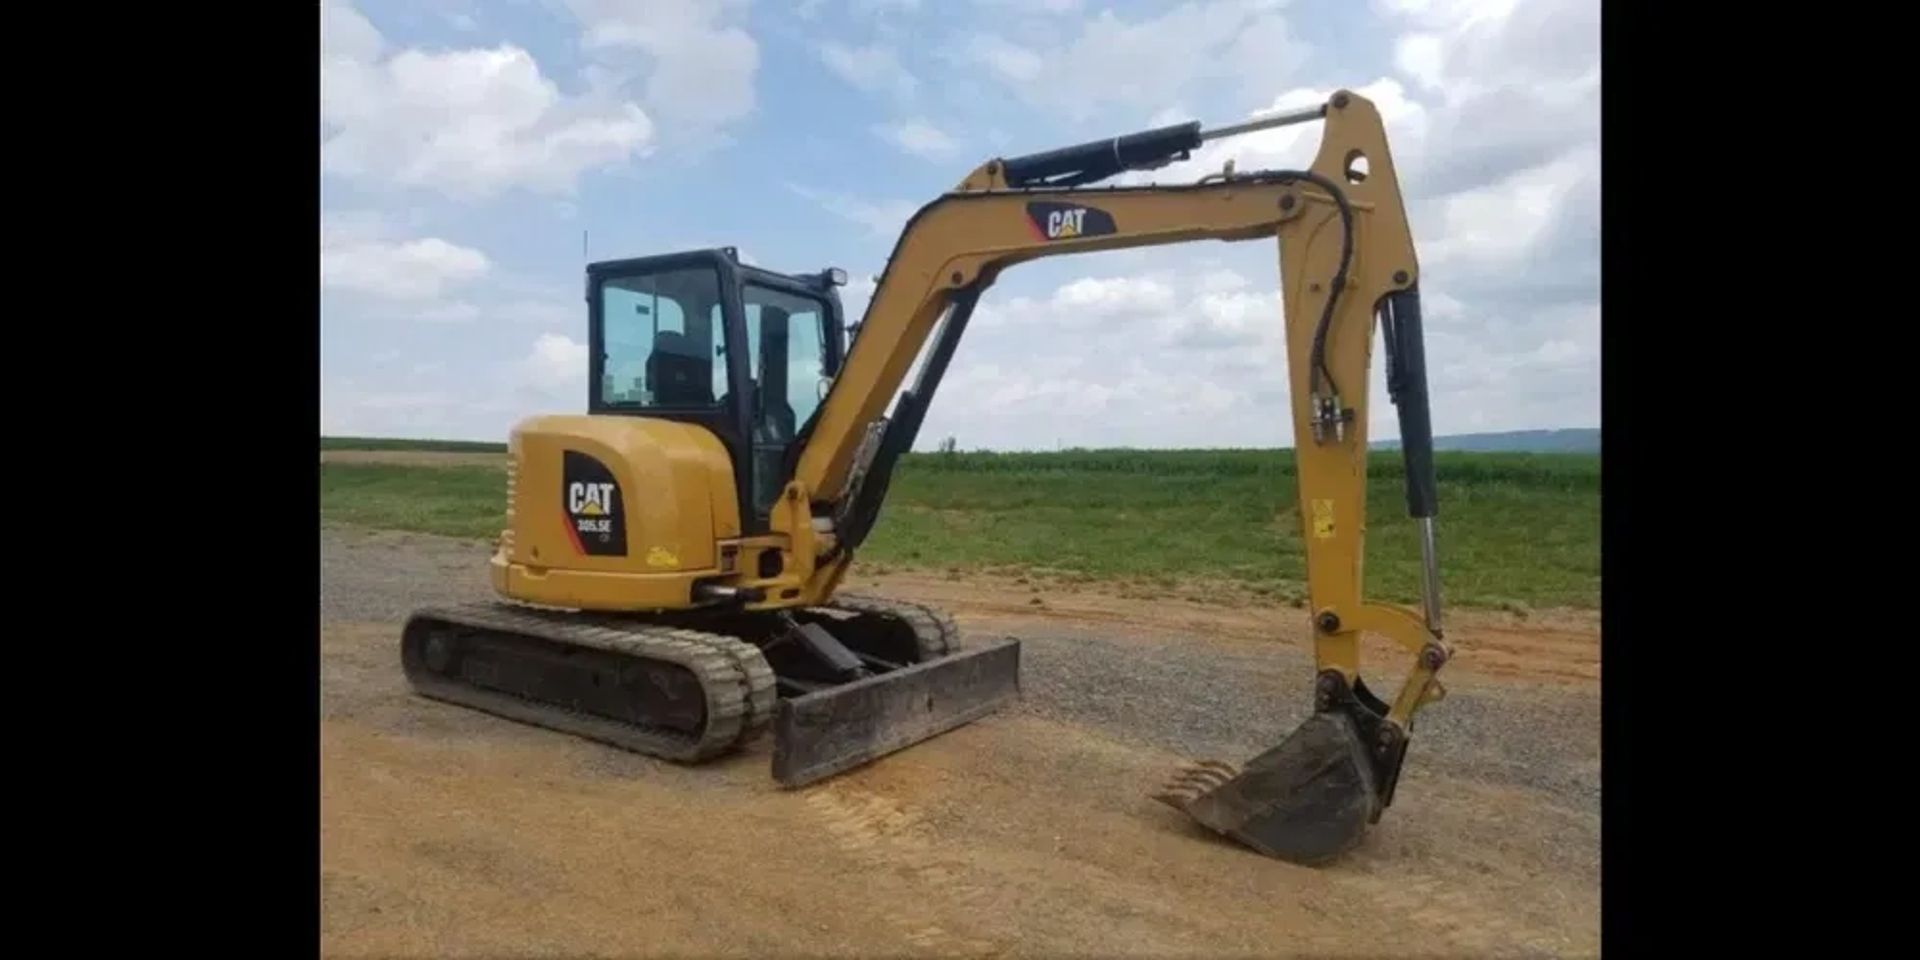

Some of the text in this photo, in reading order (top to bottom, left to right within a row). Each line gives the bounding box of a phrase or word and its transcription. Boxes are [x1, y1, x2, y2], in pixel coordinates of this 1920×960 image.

[1048, 208, 1087, 238] CAT
[569, 482, 615, 515] CAT
[577, 519, 612, 533] 305.5E
